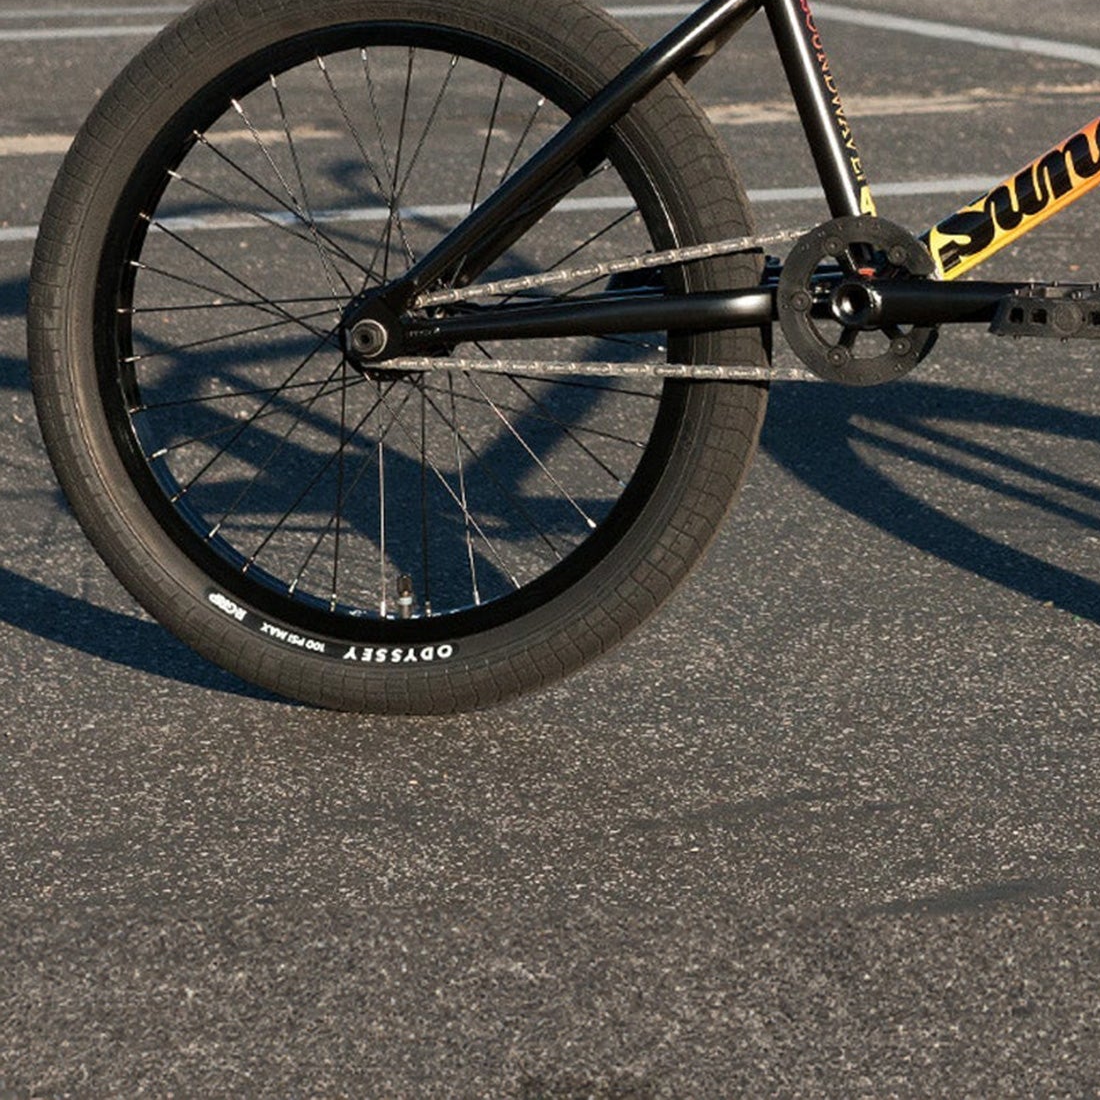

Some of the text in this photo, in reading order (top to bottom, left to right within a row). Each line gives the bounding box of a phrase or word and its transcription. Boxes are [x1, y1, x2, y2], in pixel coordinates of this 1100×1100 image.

[260, 622, 289, 643] MAX
[286, 633, 305, 647] PSI
[305, 639, 325, 653] 100
[342, 644, 453, 663] ODYSSEY
